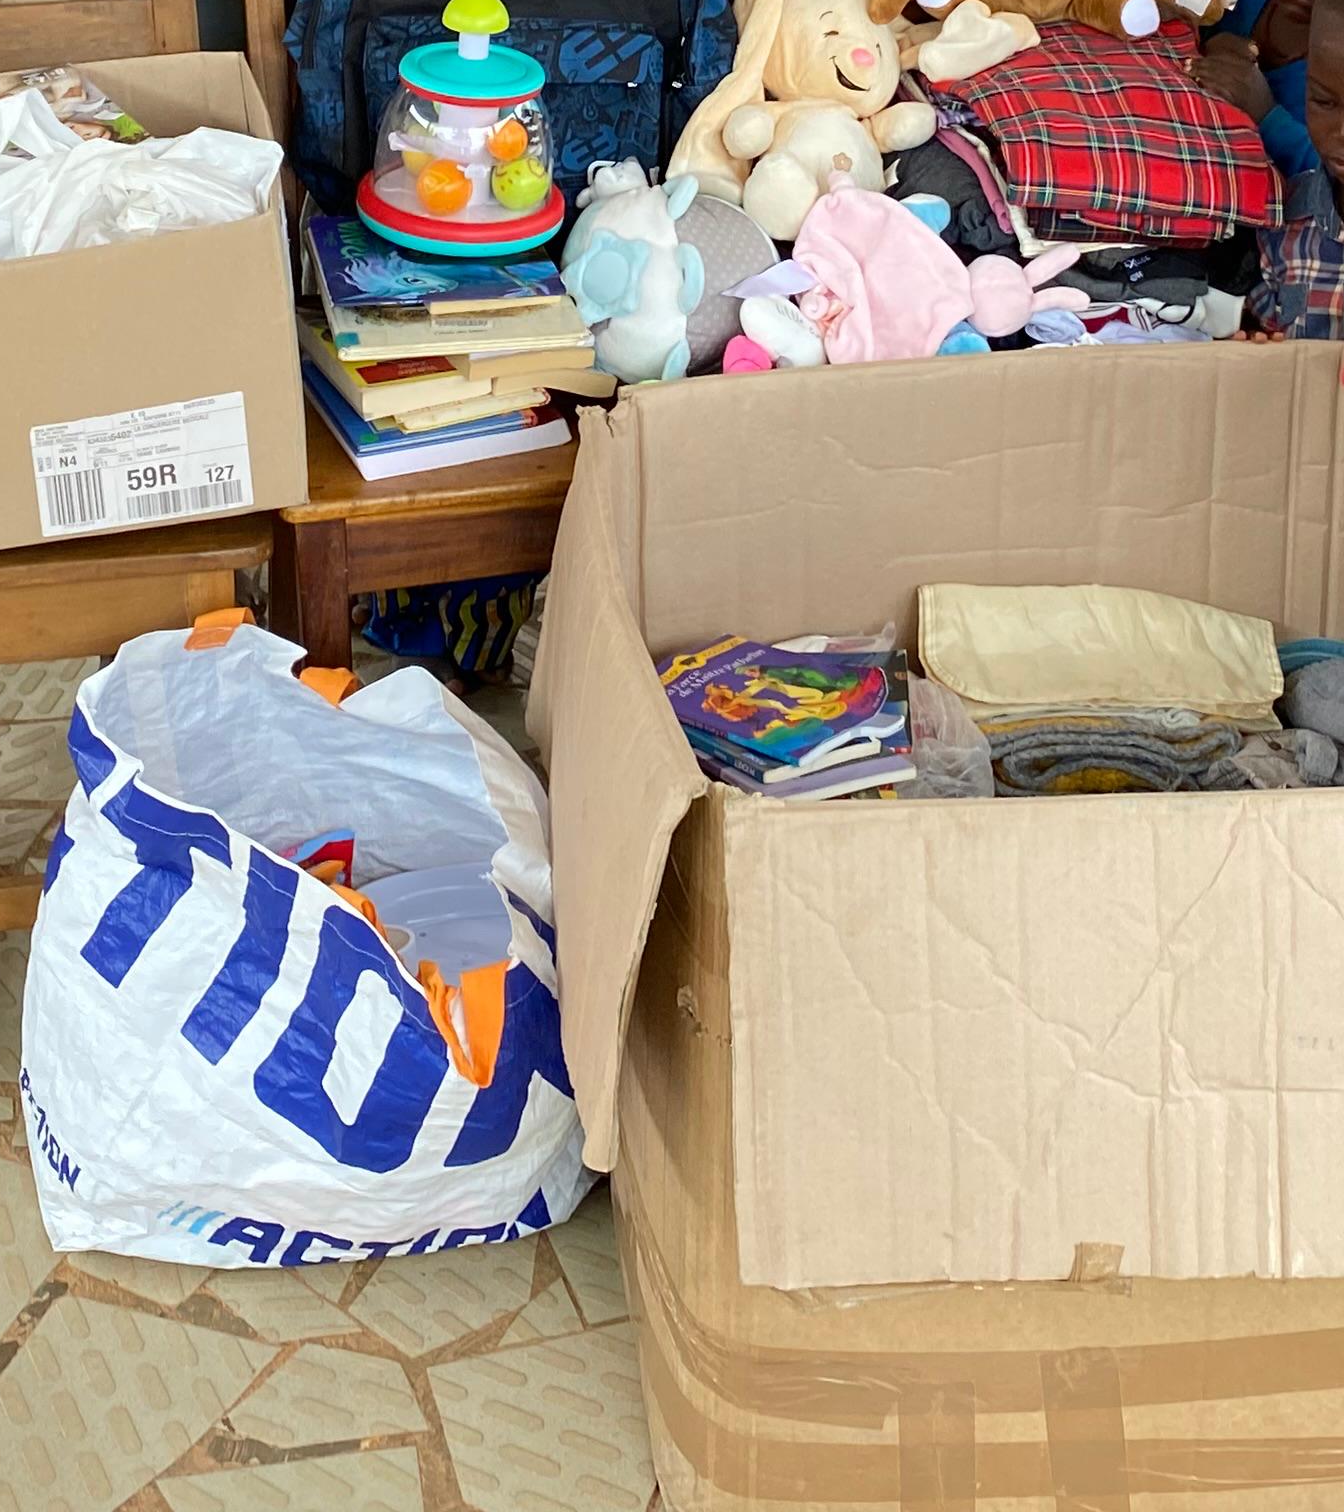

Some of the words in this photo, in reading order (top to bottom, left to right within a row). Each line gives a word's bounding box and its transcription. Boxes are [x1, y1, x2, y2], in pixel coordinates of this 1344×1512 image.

[59, 454, 78, 469] N4
[127, 463, 177, 491] 59R
[204, 464, 235, 484] 127
